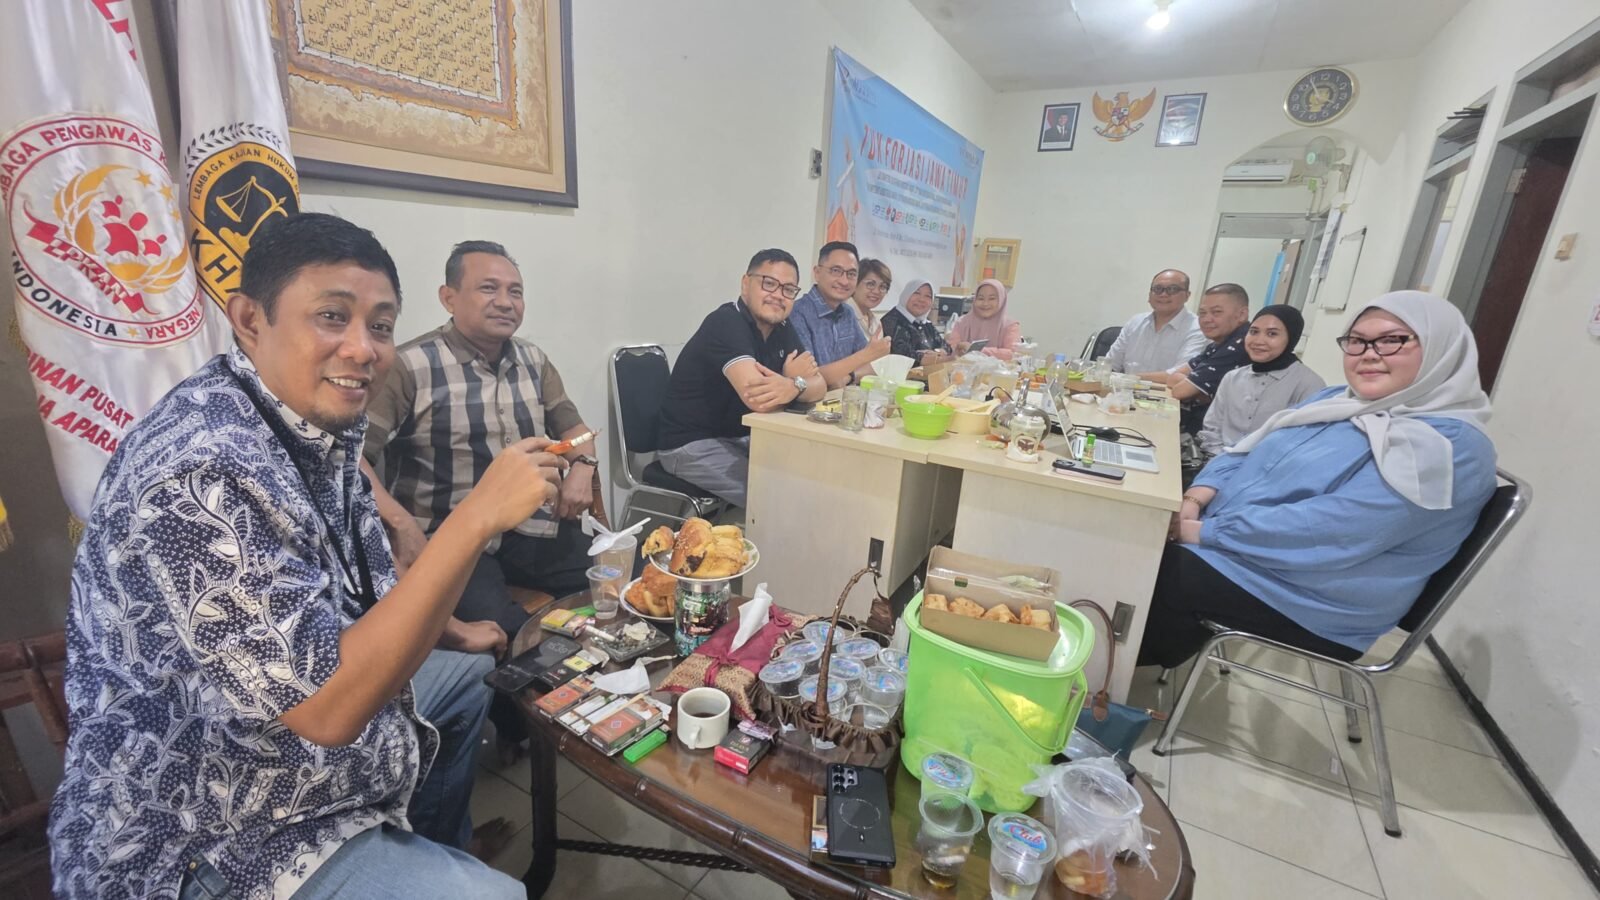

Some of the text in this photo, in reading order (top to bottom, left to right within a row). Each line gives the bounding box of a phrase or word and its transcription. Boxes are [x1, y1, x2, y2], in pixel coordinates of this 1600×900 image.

[40, 125, 153, 152] PENGAWAS
[193, 149, 295, 200] LEMBAGA KAJIAN HUKUM
[191, 228, 240, 293] KH
[145, 307, 200, 339] NEGARA
[27, 350, 134, 429] INAN PUSAT
[51, 411, 120, 455] APARA
